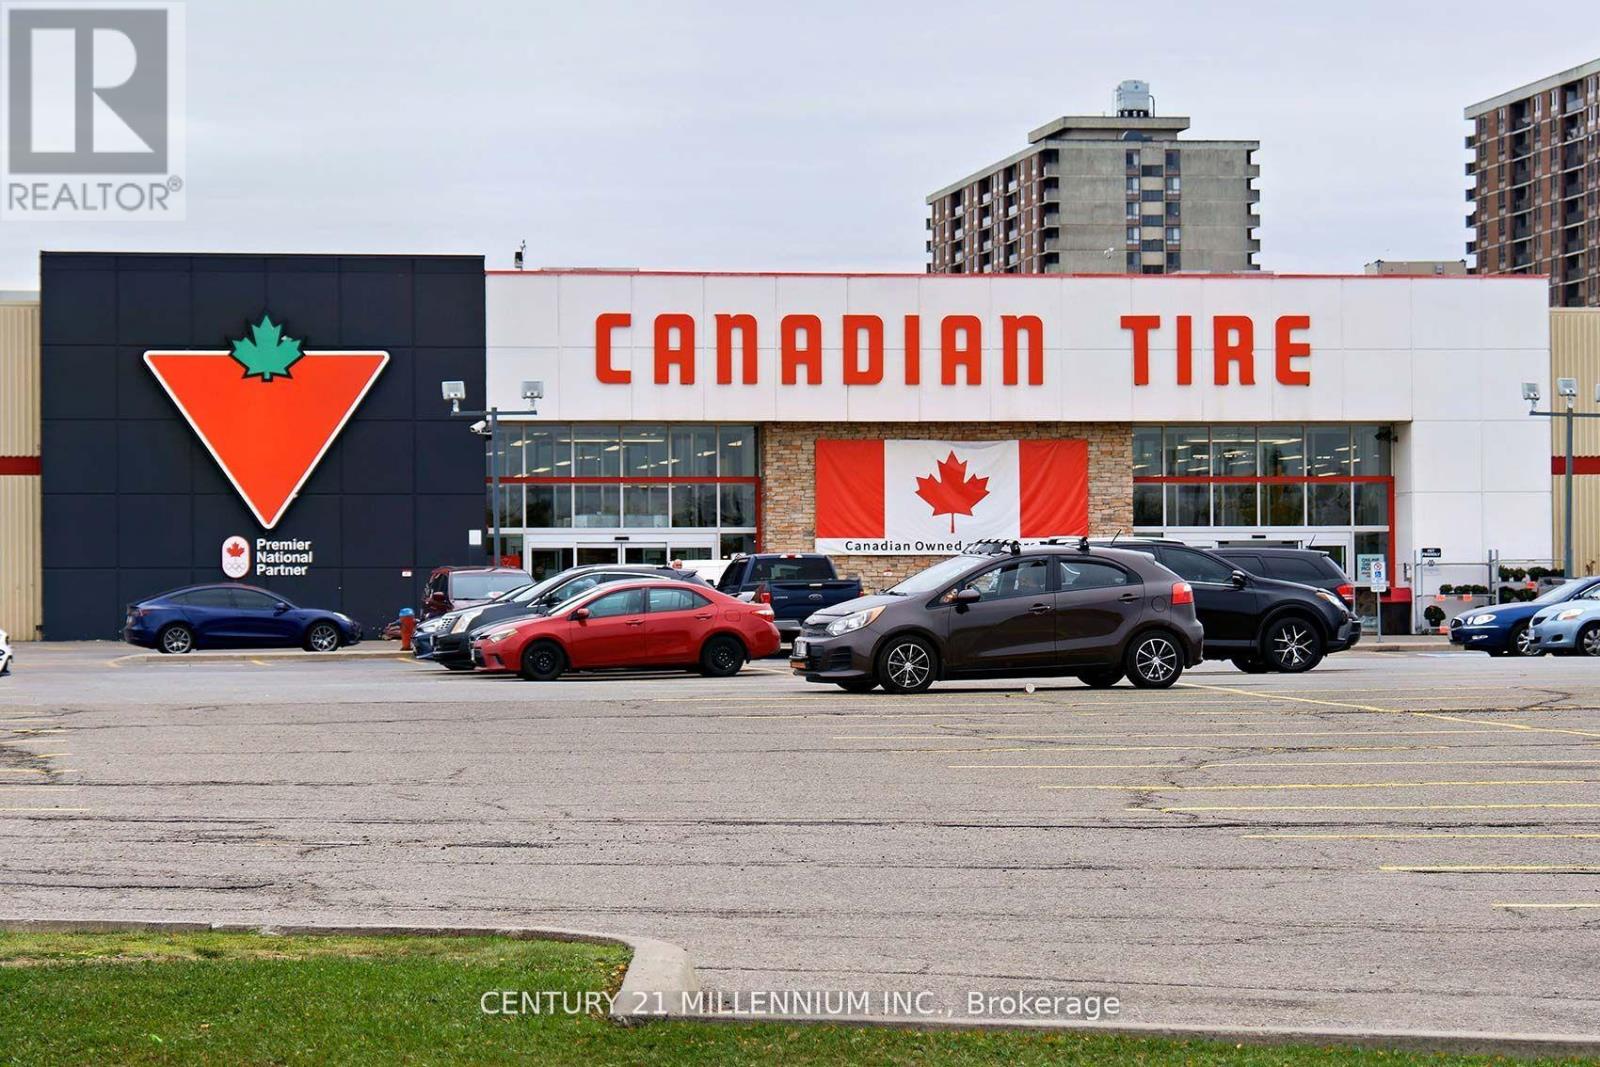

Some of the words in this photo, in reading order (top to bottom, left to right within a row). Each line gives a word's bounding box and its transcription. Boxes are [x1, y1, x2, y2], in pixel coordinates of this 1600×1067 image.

[595, 313, 1044, 386] CANADIAN
[1120, 314, 1311, 387] TIRE
[256, 538, 311, 551] Premier
[845, 540, 911, 551] Canadian
[915, 540, 963, 551] Owned
[256, 551, 313, 564] National
[256, 564, 308, 576] Partner
